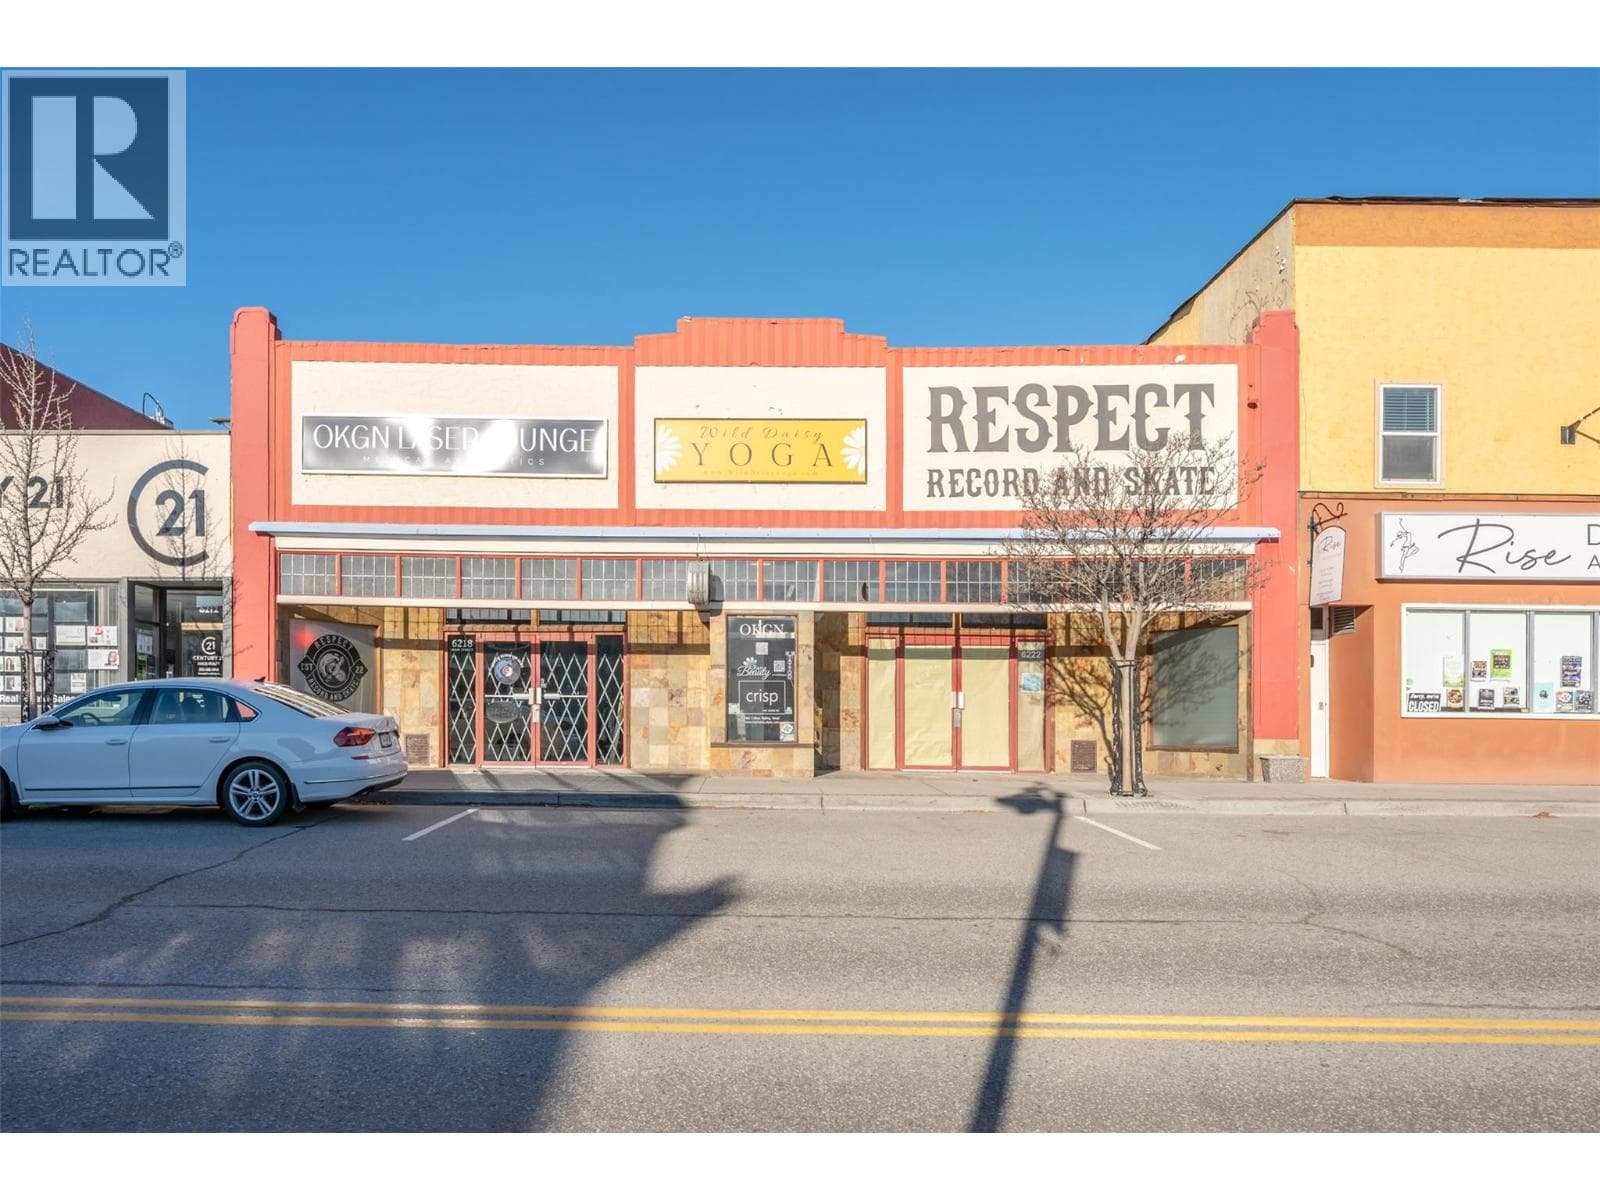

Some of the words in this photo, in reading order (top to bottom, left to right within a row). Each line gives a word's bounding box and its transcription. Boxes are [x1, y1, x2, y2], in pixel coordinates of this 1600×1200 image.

[926, 383, 1215, 453] RESPECT
[313, 424, 389, 449] OKGN
[700, 427, 753, 439] Wild
[763, 427, 823, 443] Daisy
[691, 442, 833, 467] YOGA
[28, 476, 63, 508] 21
[927, 468, 1038, 498] RECORD
[1053, 466, 1109, 496] AND
[1124, 466, 1215, 496] SKATE
[155, 489, 205, 537] 21
[1437, 518, 1572, 574] Rise
[313, 635, 354, 650] RESPECT
[451, 639, 473, 648] 6218
[1021, 650, 1041, 659] 6222
[354, 665, 364, 674] 22
[745, 689, 779, 705] crisp
[1408, 700, 1440, 712] CLOSED
